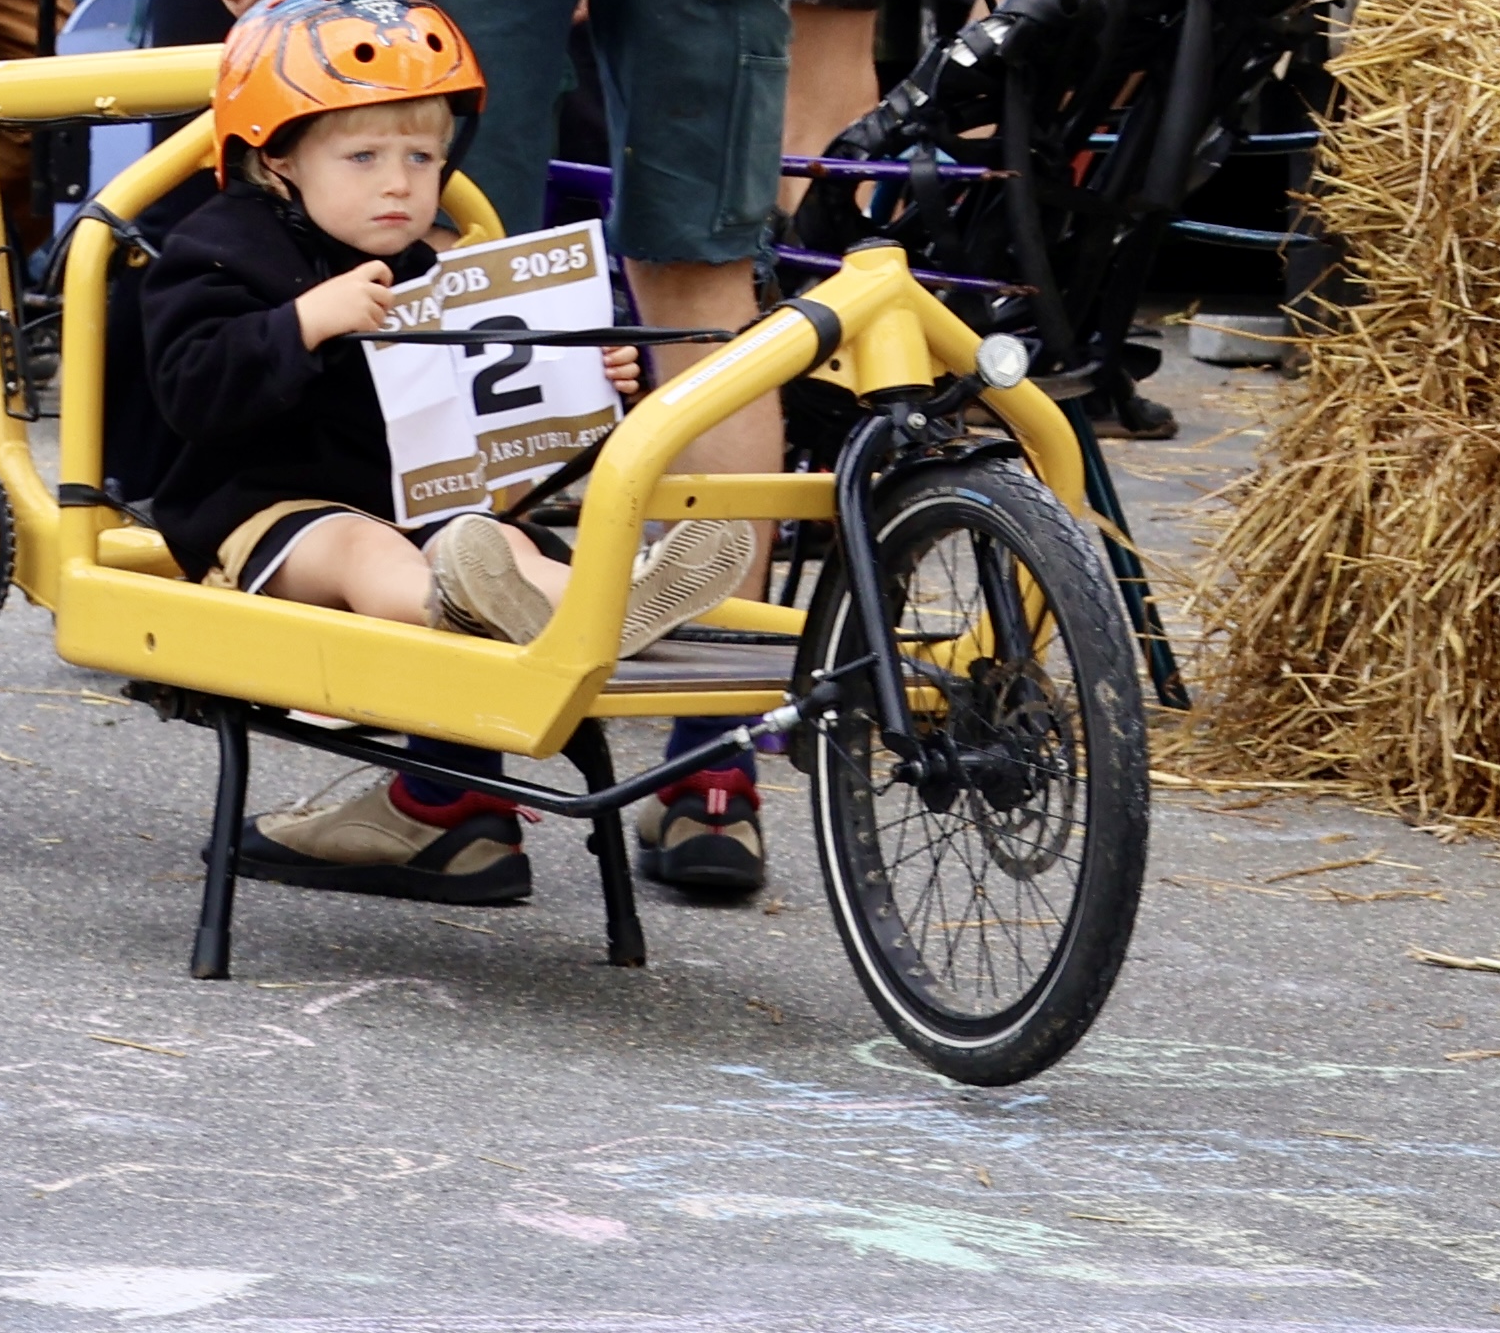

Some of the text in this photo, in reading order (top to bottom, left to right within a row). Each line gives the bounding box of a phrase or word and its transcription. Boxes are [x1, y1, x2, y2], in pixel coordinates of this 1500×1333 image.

[510, 243, 588, 282] 2025
[463, 315, 544, 417] 2
[491, 440, 524, 466] ÅRS
